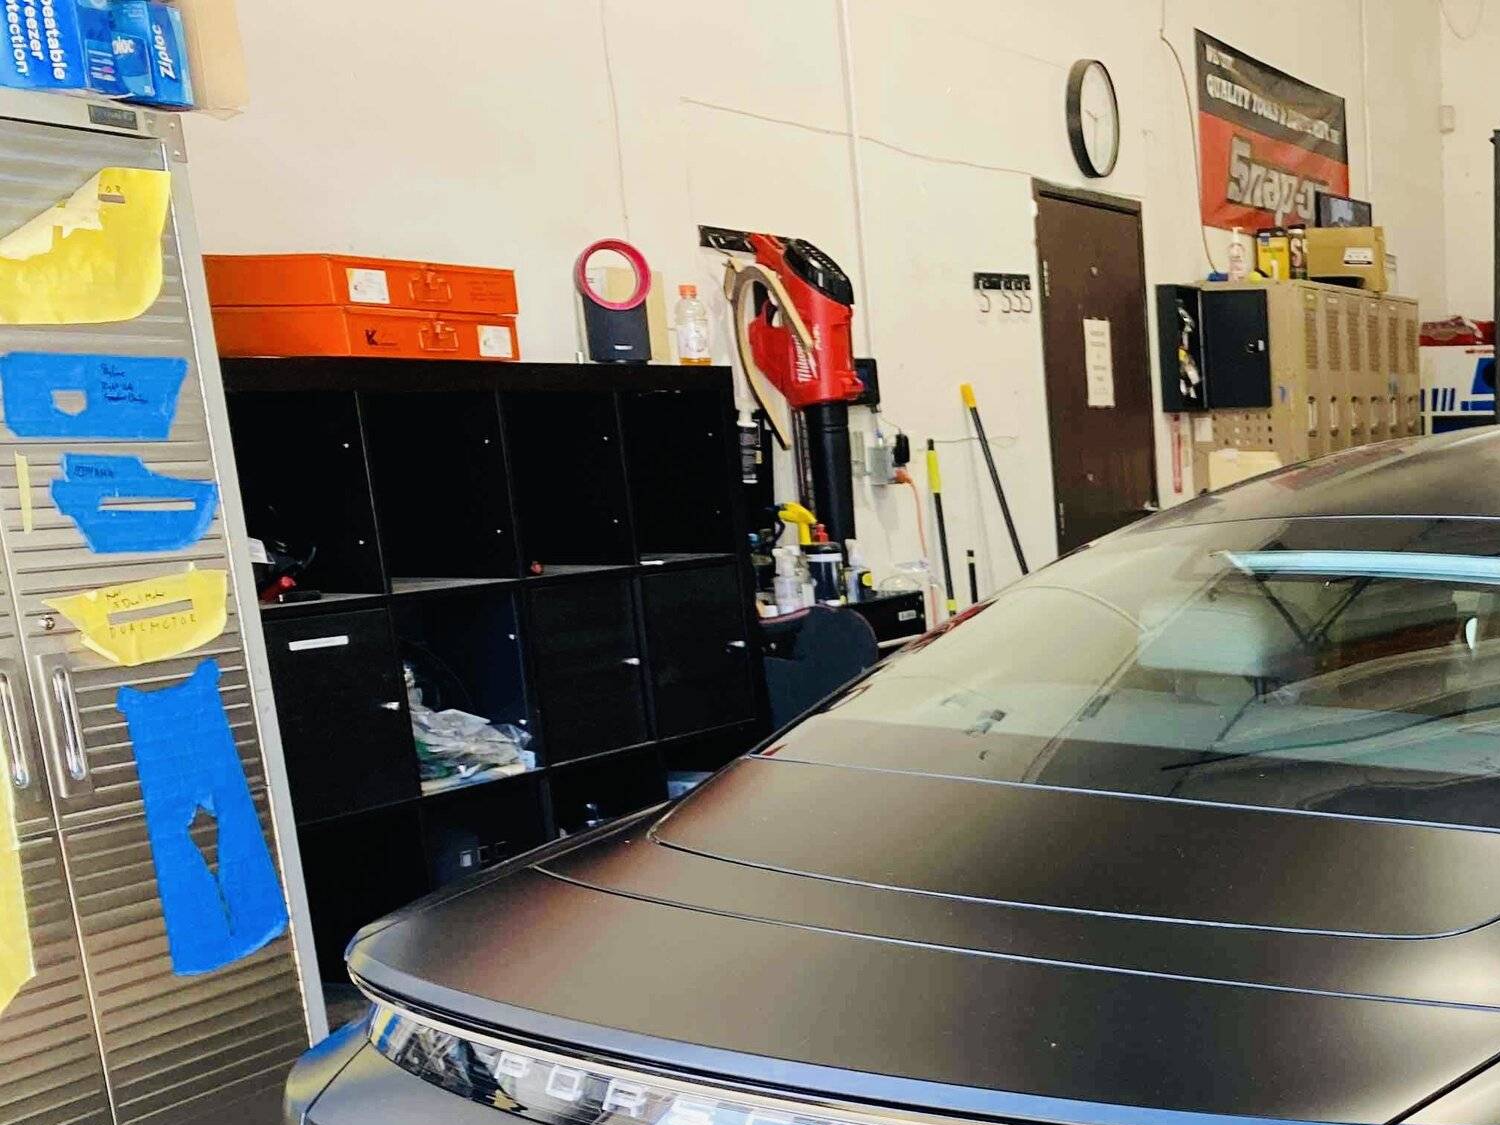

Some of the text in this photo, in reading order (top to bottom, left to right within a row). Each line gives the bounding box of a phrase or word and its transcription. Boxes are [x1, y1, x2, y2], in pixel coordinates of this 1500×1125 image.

[41, 0, 68, 80] eatable
[152, 24, 176, 79] Ziploc
[1228, 137, 1330, 228] Snap-o
